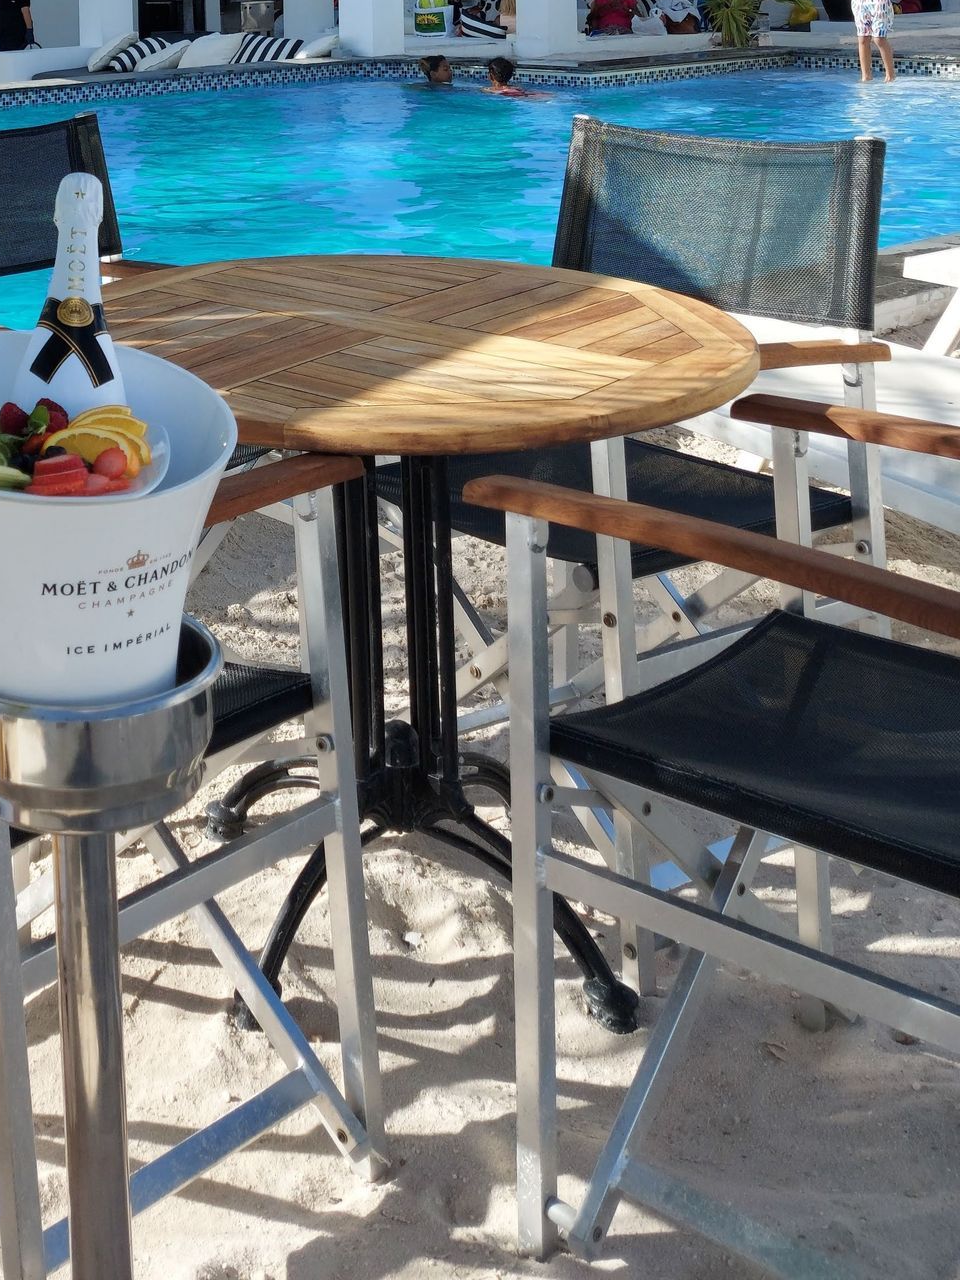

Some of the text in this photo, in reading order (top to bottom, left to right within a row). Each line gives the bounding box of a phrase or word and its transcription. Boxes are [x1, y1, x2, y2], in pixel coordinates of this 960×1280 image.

[67, 226, 87, 292] MOËT
[41, 580, 101, 596] MOËT
[107, 581, 117, 592] &
[124, 547, 193, 589] CHANDON
[78, 579, 172, 610] CHAMPAGNE
[66, 622, 171, 655] ICE IMPÉRIAL
